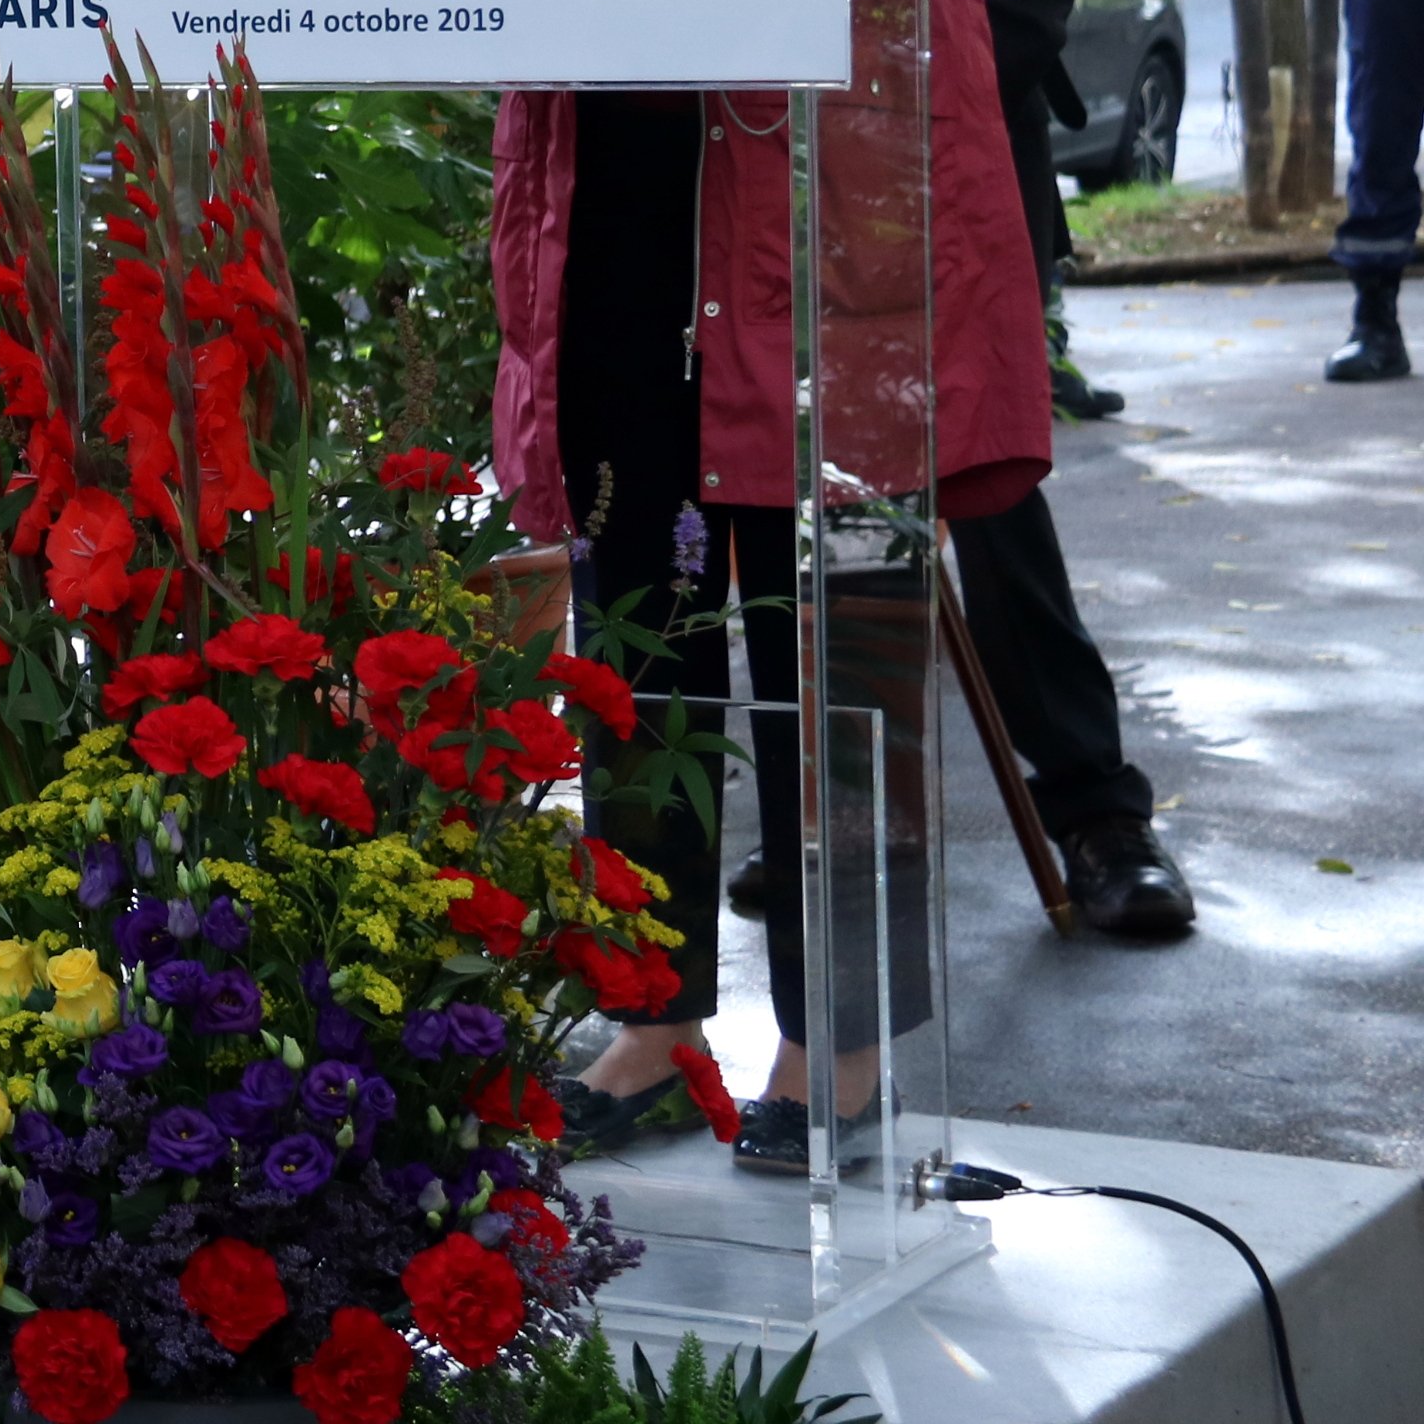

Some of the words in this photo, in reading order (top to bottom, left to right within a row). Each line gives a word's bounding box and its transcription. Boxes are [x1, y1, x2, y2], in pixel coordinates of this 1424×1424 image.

[170, 7, 292, 35] Vendredi
[298, 8, 317, 34] 4
[322, 6, 430, 34] octobre
[437, 6, 506, 33] 2019
